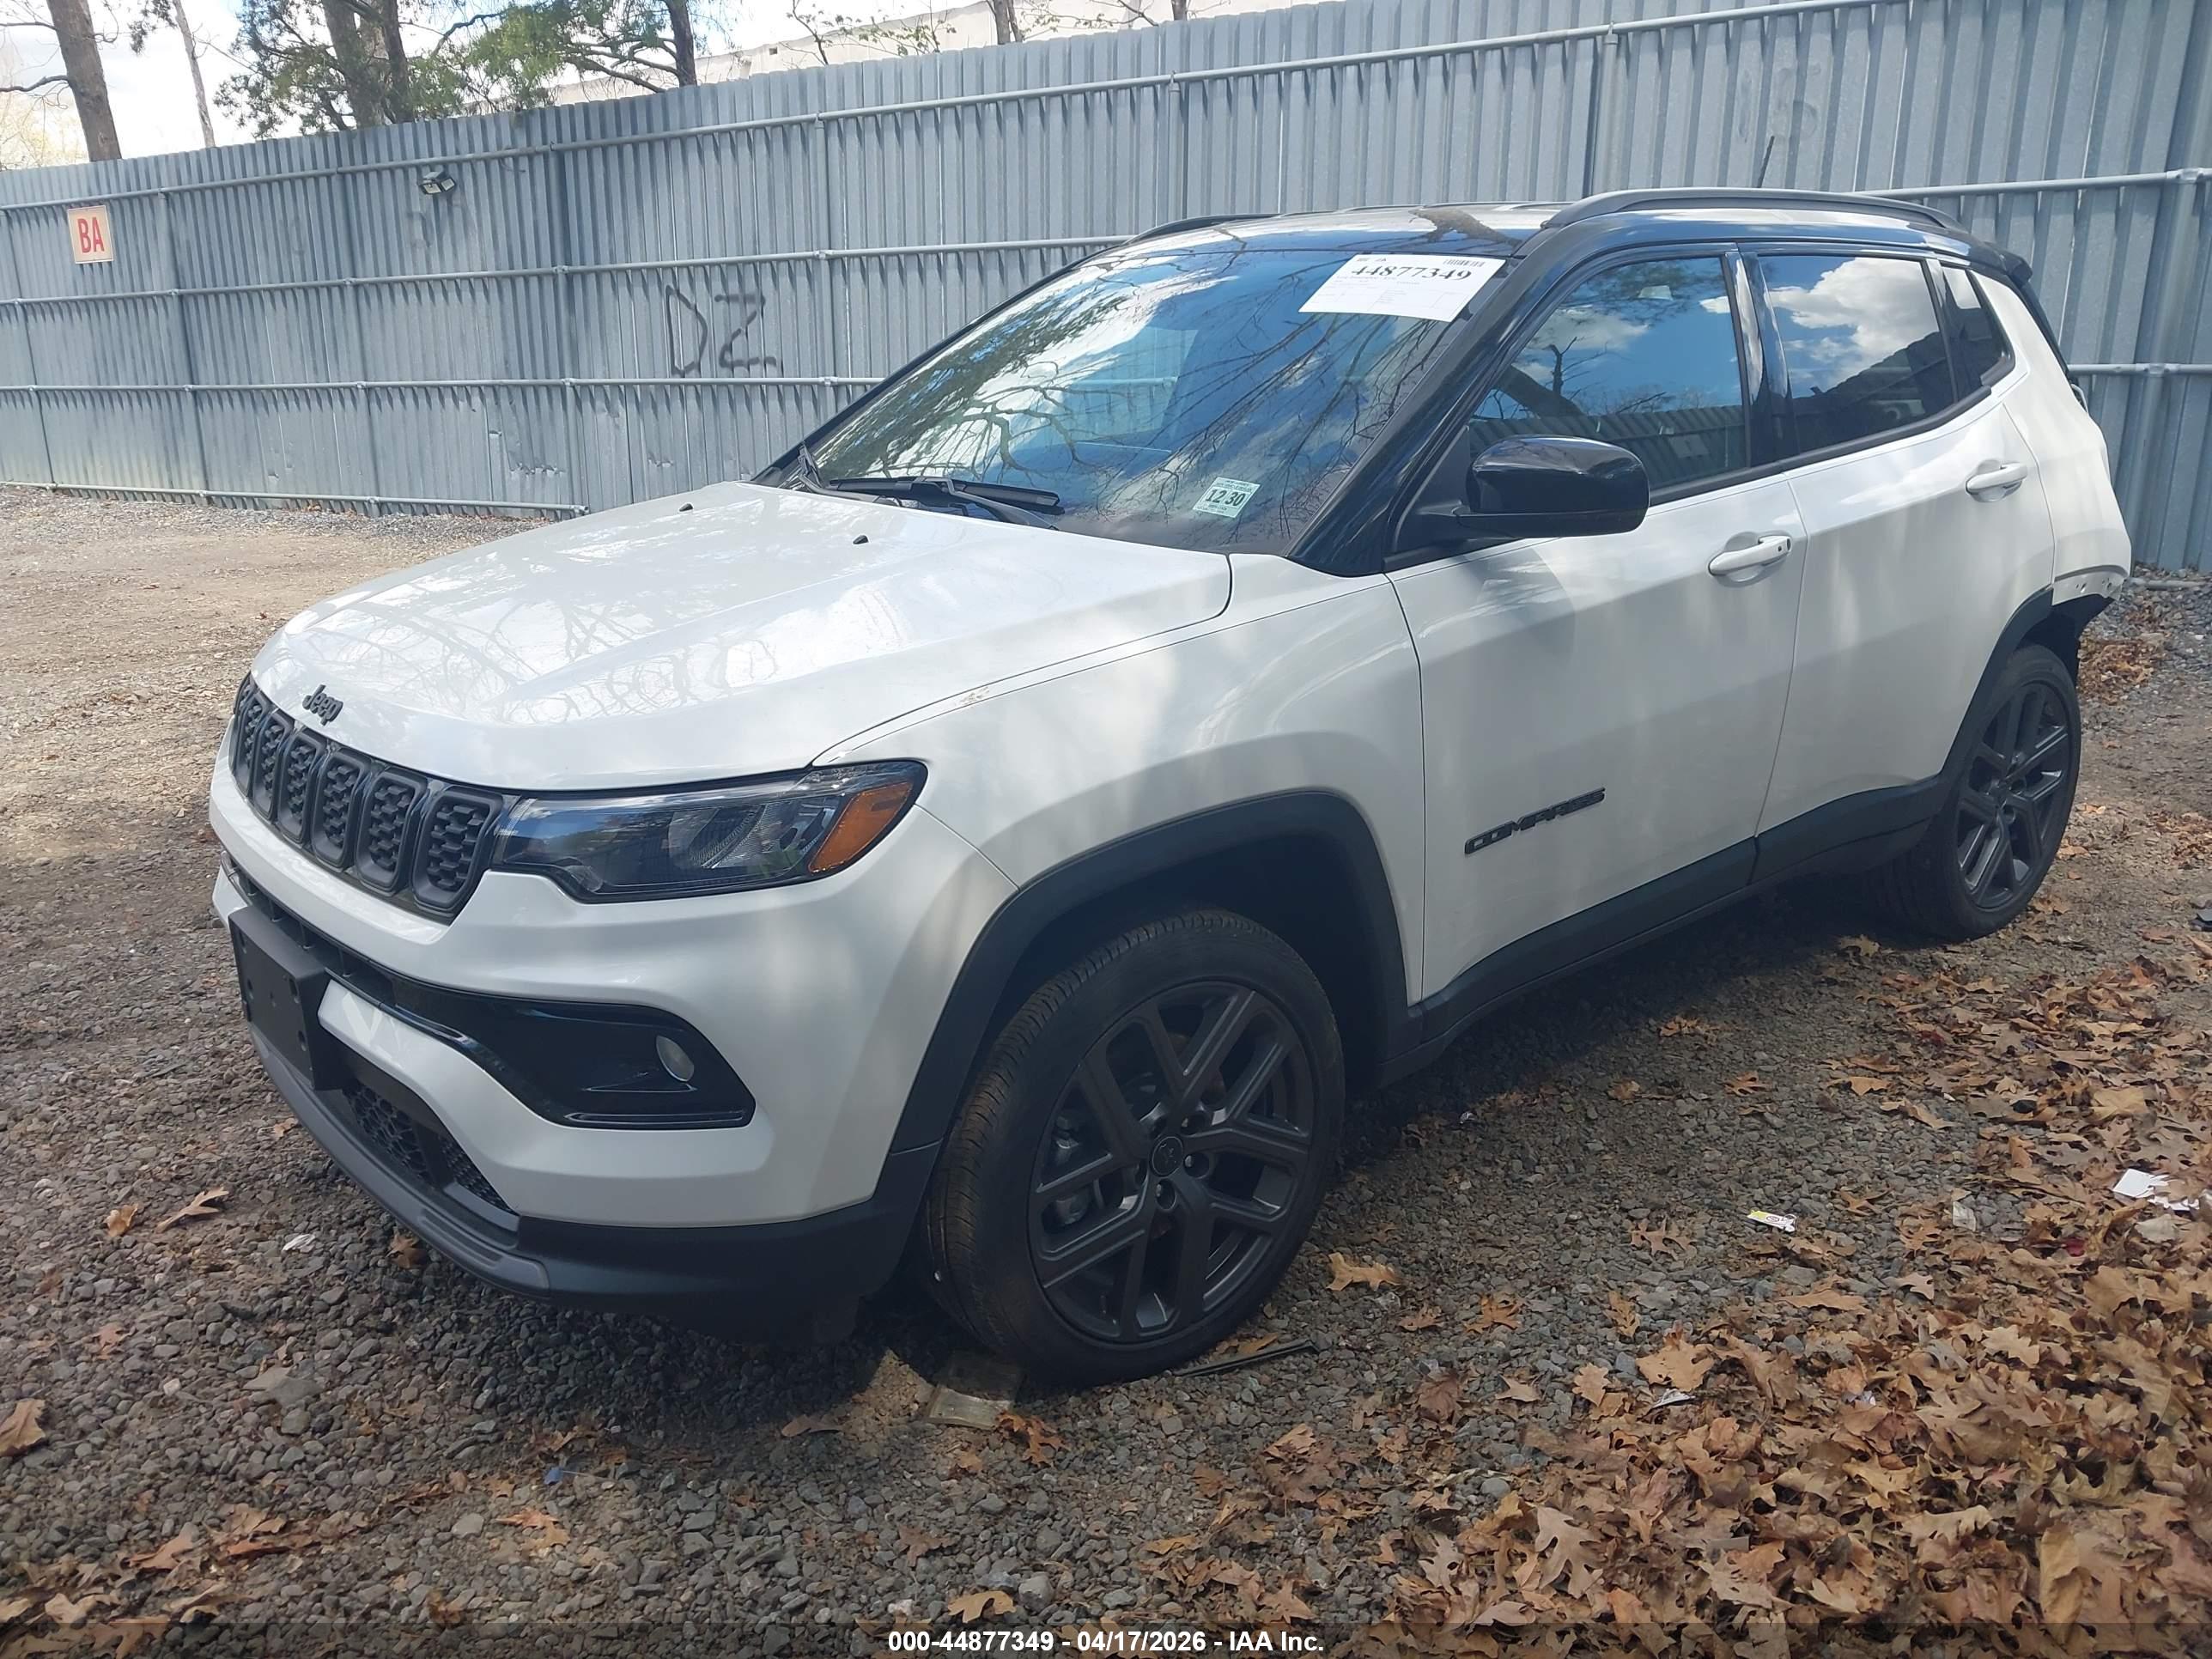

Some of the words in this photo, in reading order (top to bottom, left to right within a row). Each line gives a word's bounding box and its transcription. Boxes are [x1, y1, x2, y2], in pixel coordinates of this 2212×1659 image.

[77, 216, 105, 253] BA
[1352, 265, 1472, 280] 44877349
[302, 684, 343, 726] Jeep
[1464, 787, 1606, 854] COMPASS
